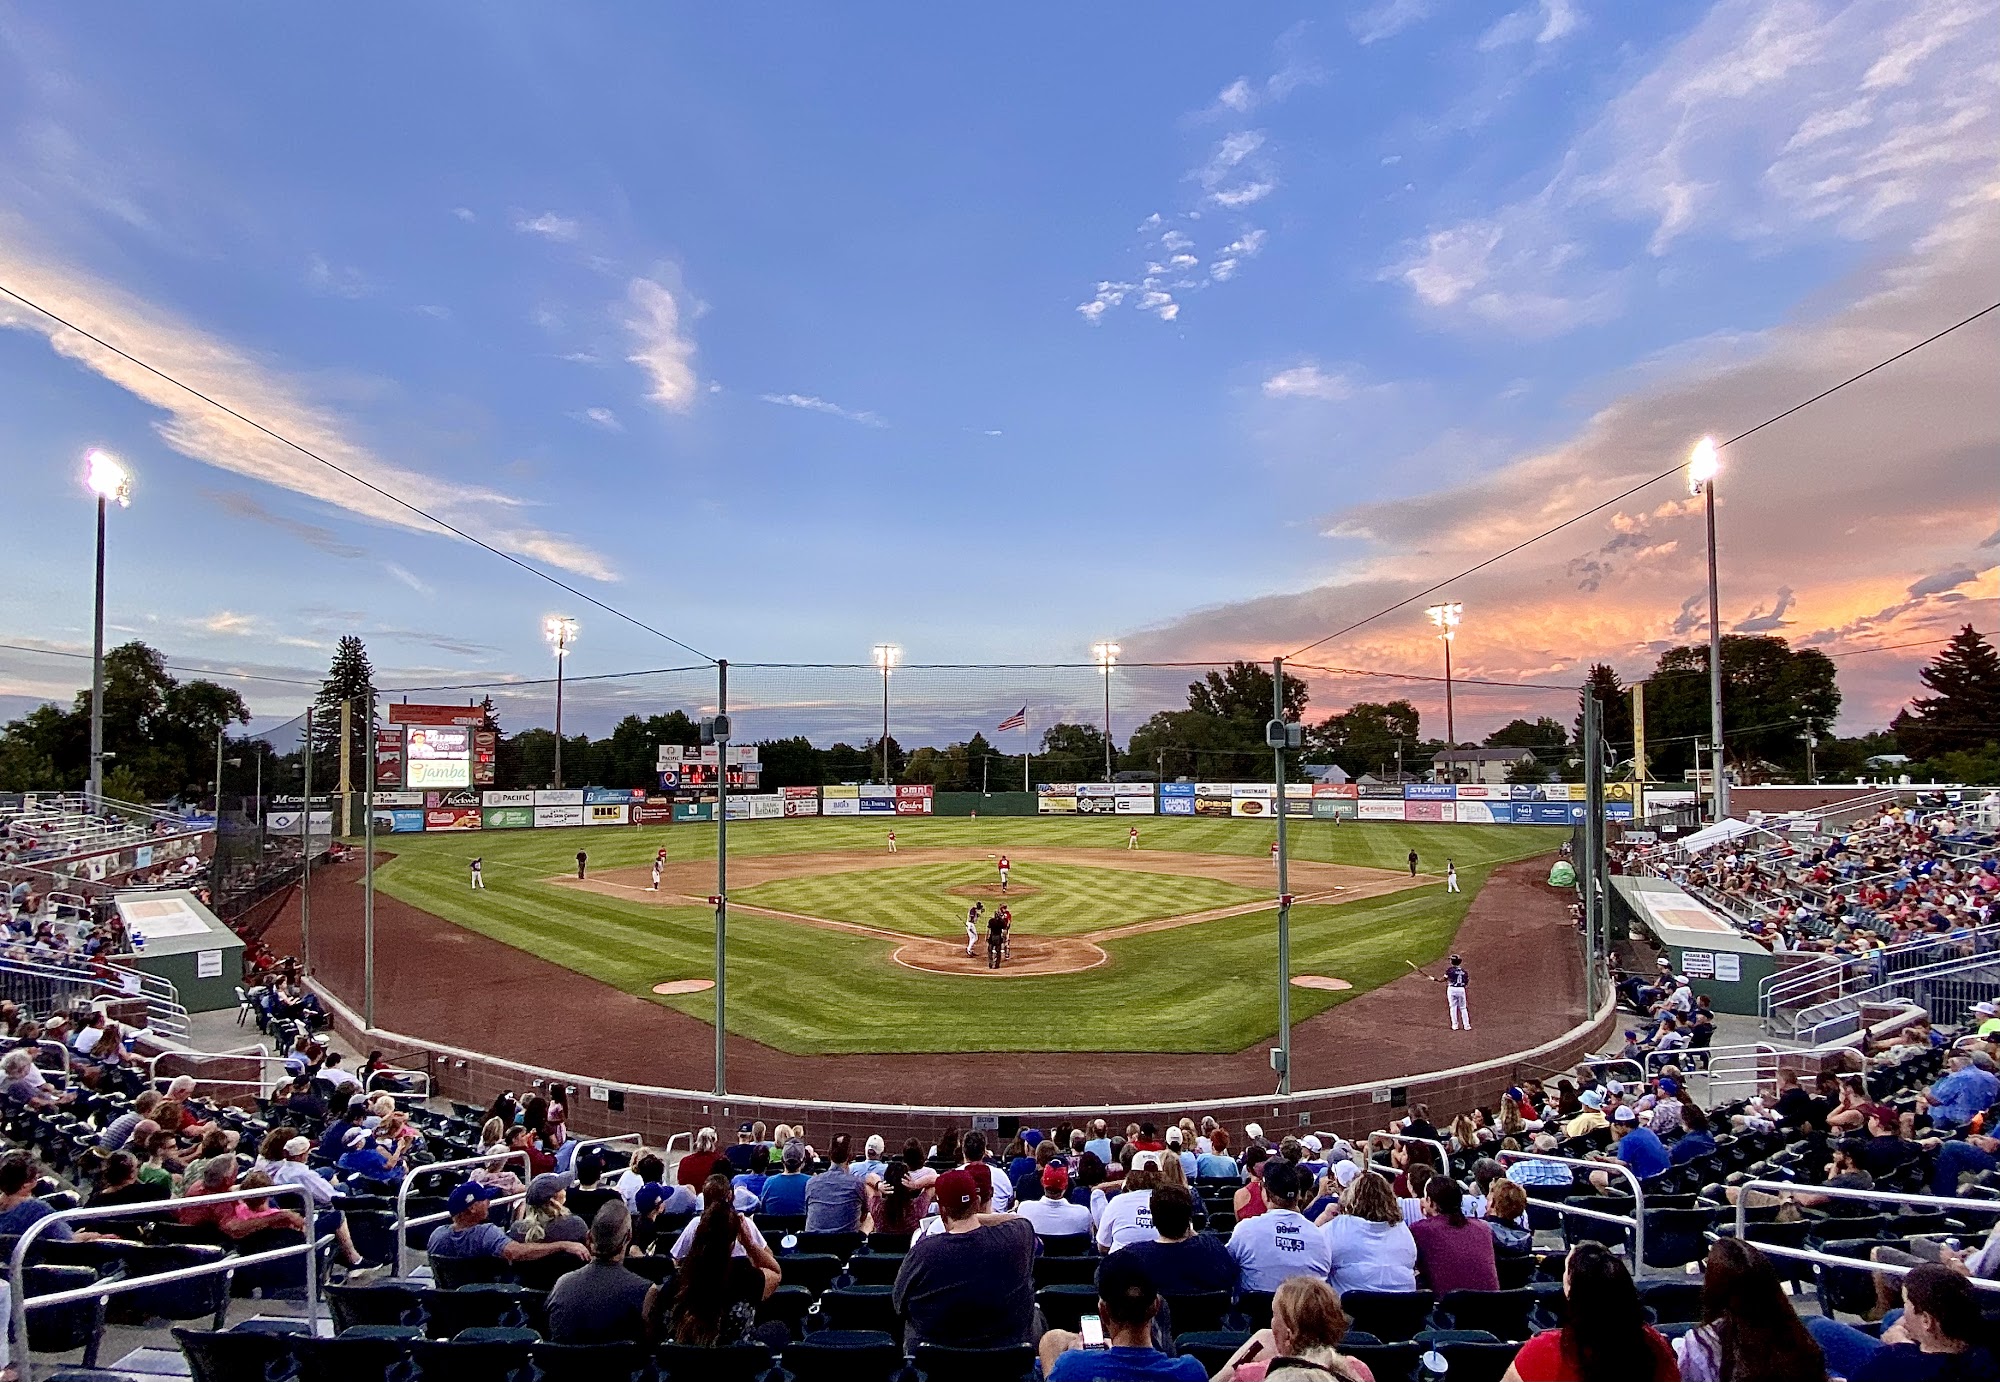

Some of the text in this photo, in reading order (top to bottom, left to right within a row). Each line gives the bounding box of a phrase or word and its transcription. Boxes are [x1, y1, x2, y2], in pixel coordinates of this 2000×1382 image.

[416, 763, 466, 783] jamba
[1409, 785, 1452, 794] STUKENT
[447, 796, 480, 804] Rockwell
[1165, 804, 1191, 812] WORLD
